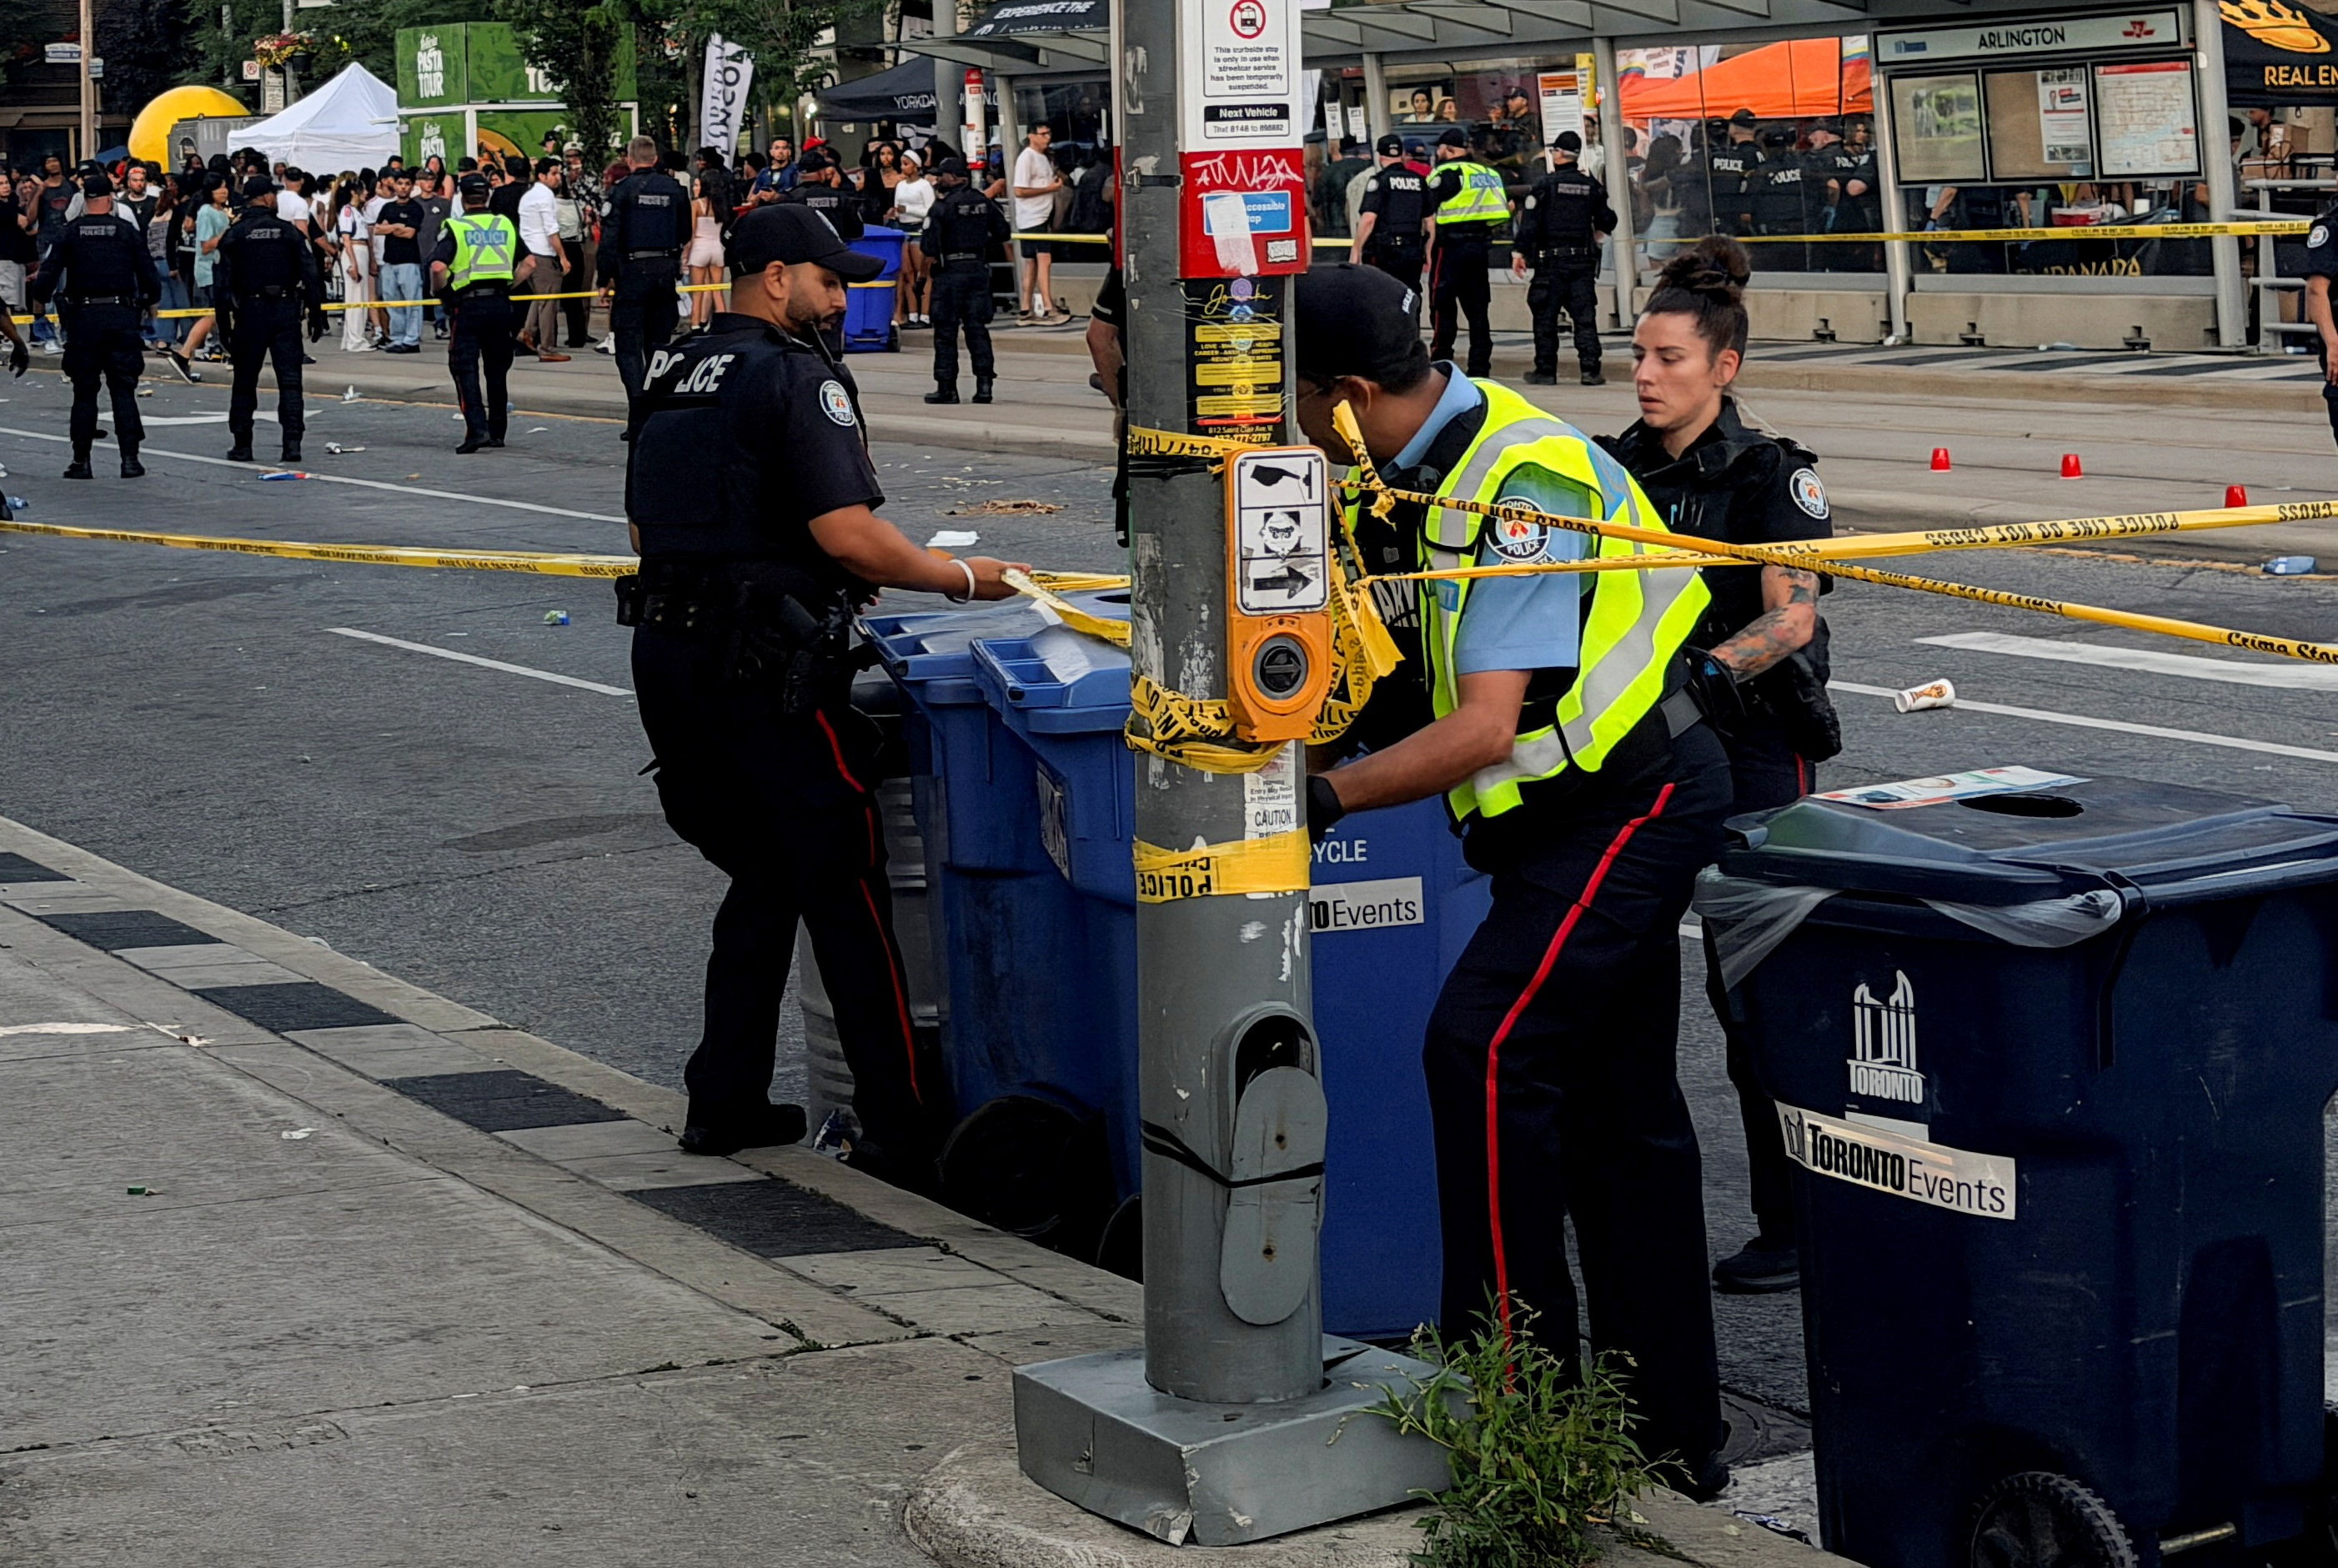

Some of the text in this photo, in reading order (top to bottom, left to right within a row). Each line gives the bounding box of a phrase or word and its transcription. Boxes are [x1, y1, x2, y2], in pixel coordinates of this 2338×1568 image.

[1978, 26, 2065, 50] ARLINGTON
[418, 49, 443, 73] PASTA
[418, 72, 444, 98] TOUR
[2264, 65, 2316, 85] REAL
[1219, 107, 1278, 118] Next Vehicle
[1390, 177, 1421, 191] POLICE
[1247, 203, 1286, 212] ccessible
[2278, 502, 2332, 521] CROSS
[1925, 513, 2180, 547] POLICE LINE DO NOT CROSS
[1507, 540, 1540, 556] POLICE
[2227, 632, 2289, 655] Crime
[1255, 808, 1292, 827] CAUTION
[1309, 839, 1367, 864] YCLE
[1141, 874, 1212, 898] POLICE
[1332, 898, 1417, 928] Events
[1847, 1060, 1926, 1105] TORONTO
[1807, 1123, 2006, 1215] TORONTO Events
